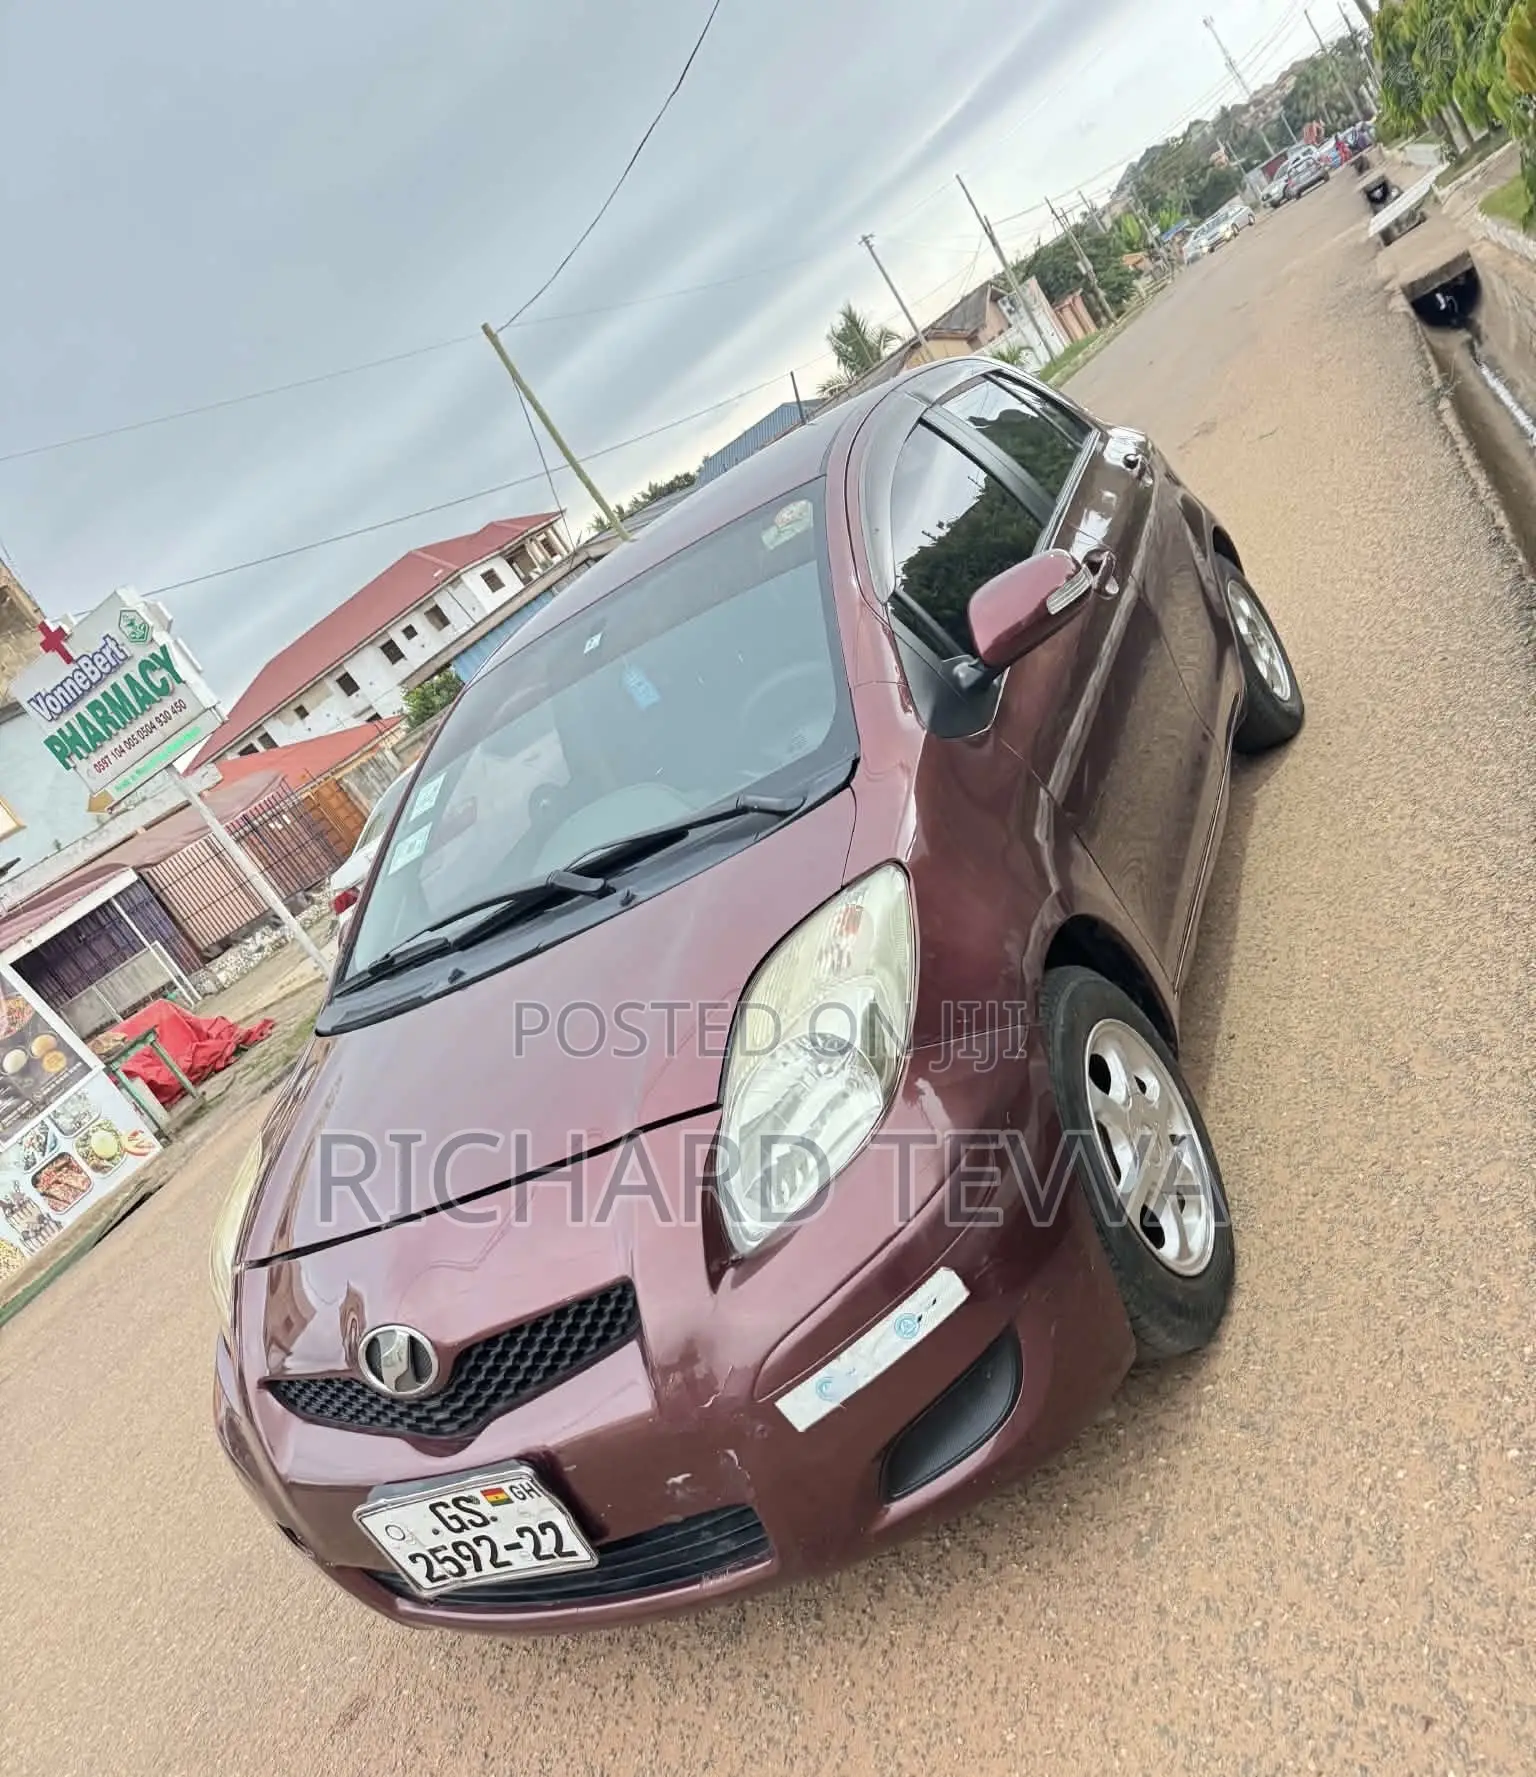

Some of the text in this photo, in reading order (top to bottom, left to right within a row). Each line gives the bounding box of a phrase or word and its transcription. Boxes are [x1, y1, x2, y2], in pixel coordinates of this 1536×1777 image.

[27, 634, 130, 722] VonneBert
[43, 644, 184, 771] PHARMACY
[93, 755, 113, 774] 0597
[111, 744, 126, 760] 104
[155, 710, 172, 727] 930
[171, 699, 187, 715] 450
[508, 1482, 542, 1501] GH
[407, 1520, 579, 1584] 2592-22
